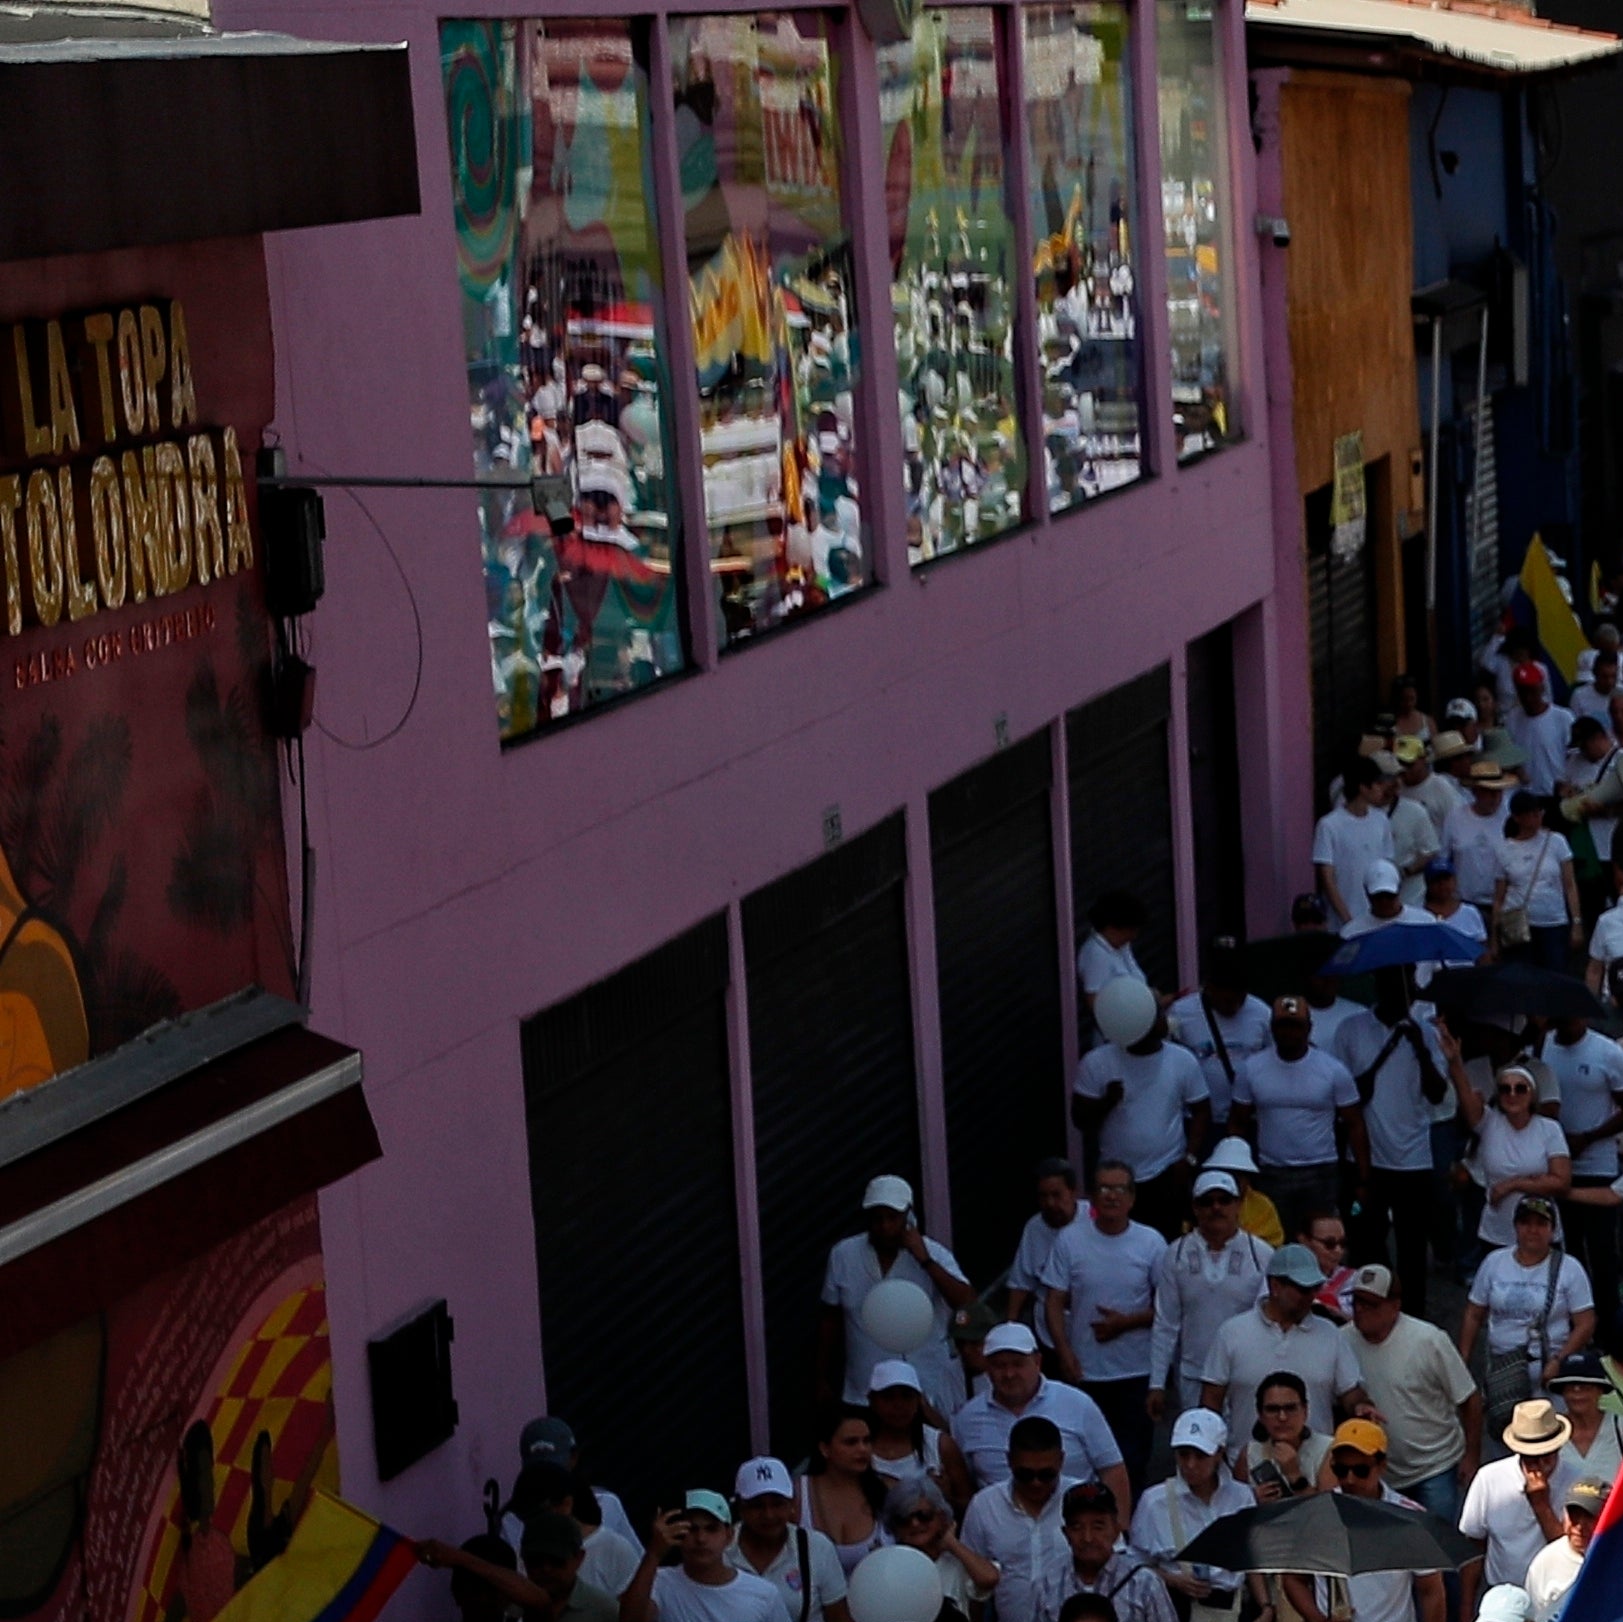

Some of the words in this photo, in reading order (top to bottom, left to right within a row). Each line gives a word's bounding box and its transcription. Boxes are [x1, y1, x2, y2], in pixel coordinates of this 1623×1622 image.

[14, 319, 82, 459] LA
[85, 299, 199, 442] TOPA
[0, 425, 255, 638] TOLONDRA
[85, 636, 123, 671] CON
